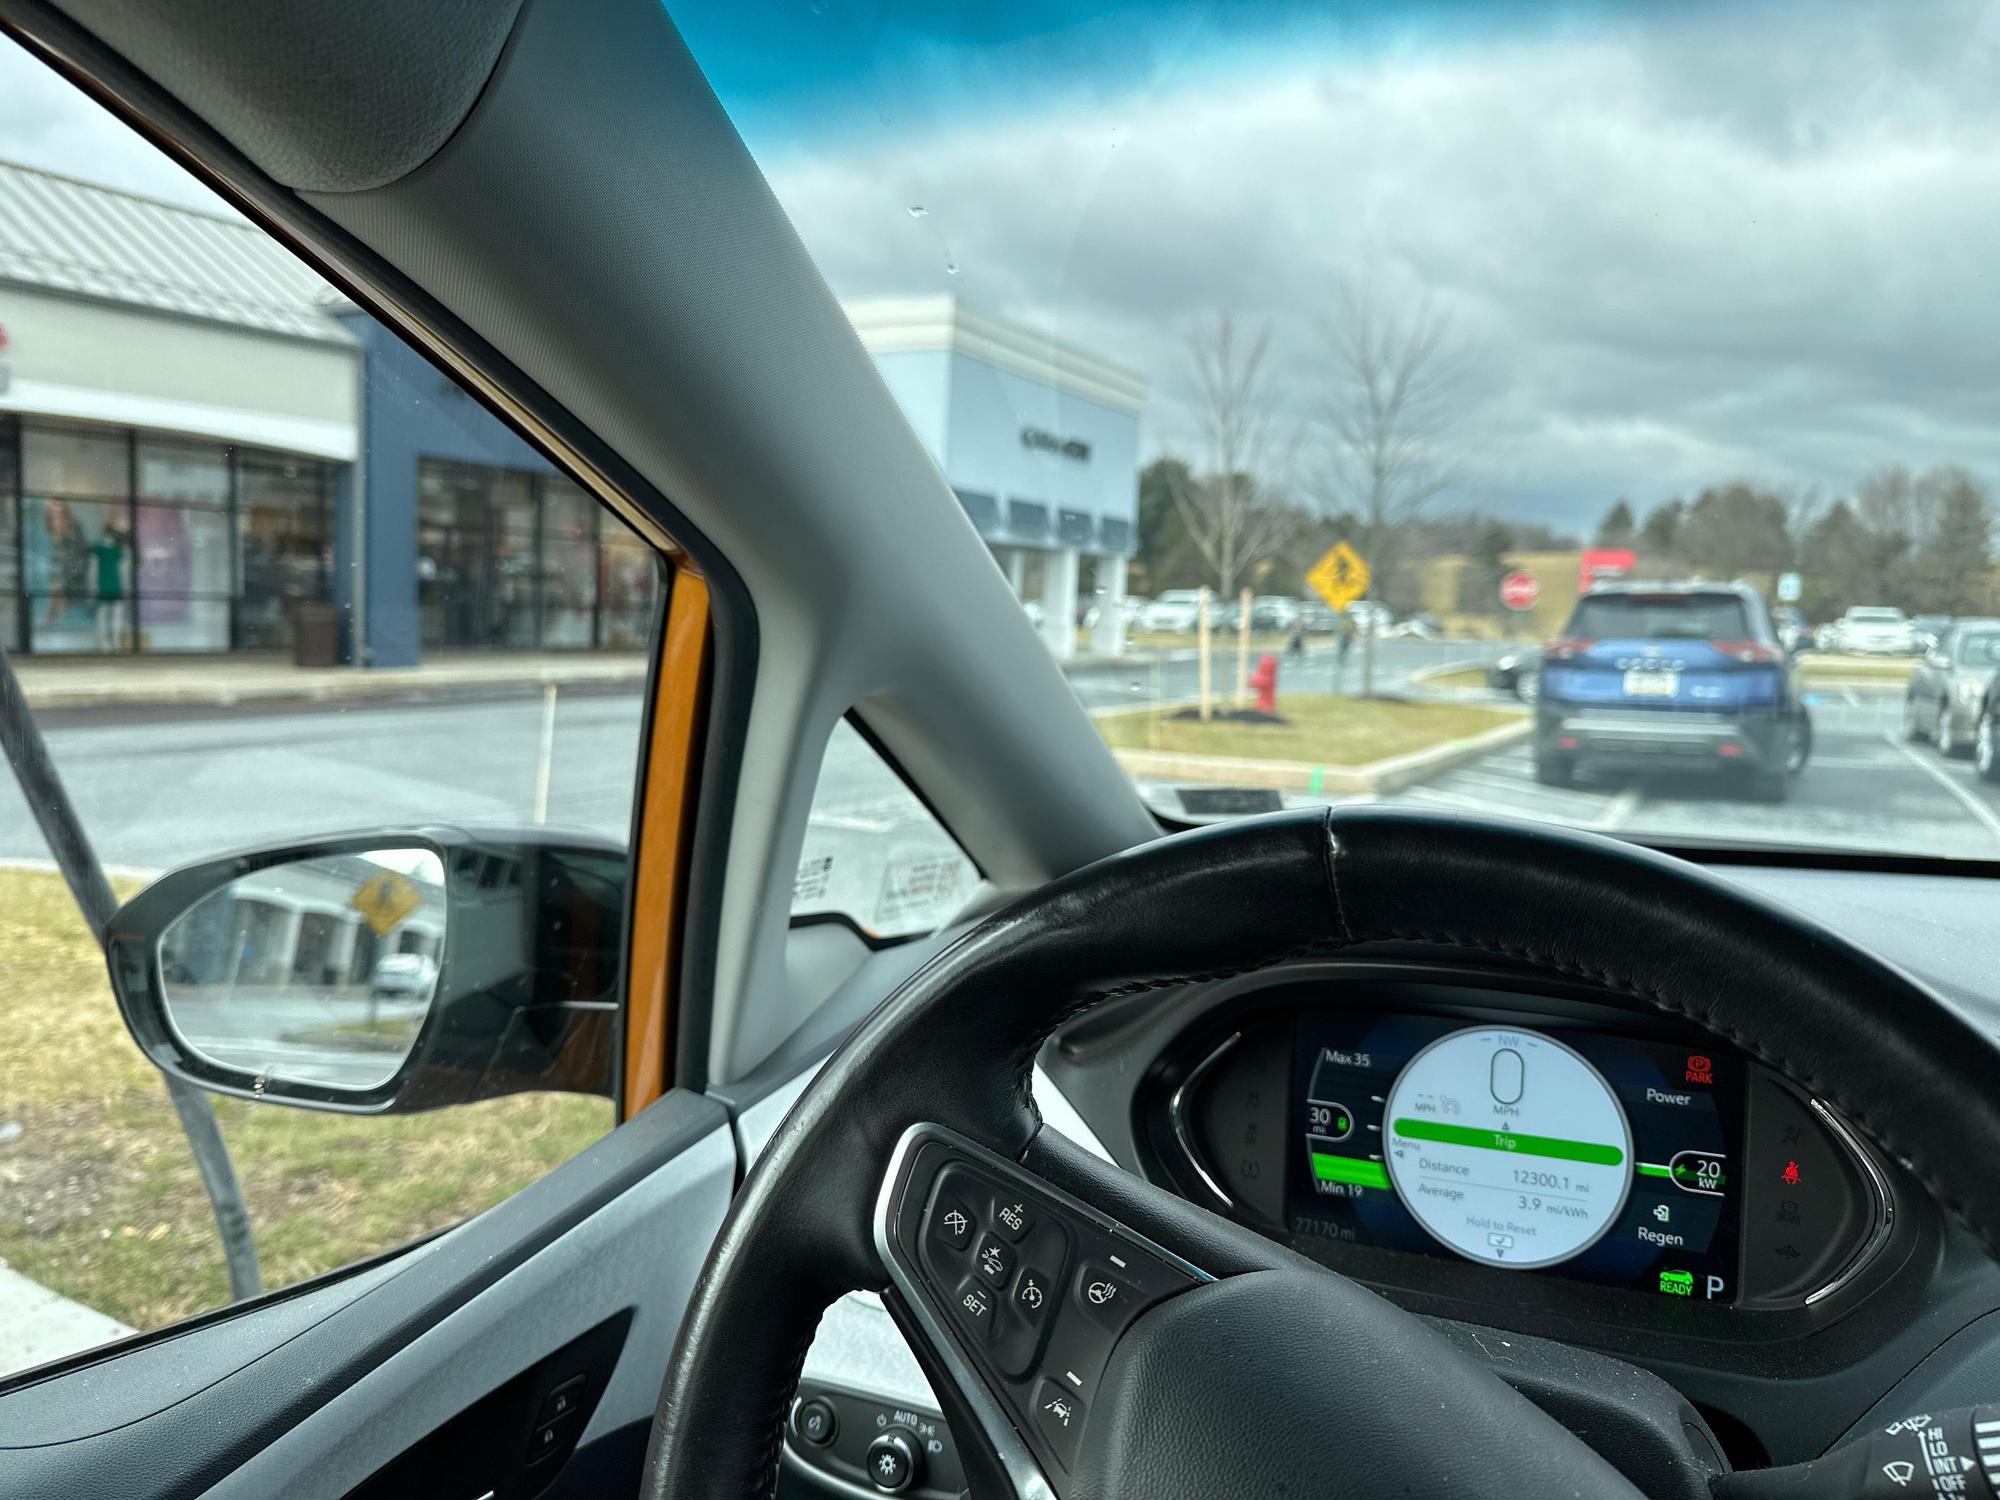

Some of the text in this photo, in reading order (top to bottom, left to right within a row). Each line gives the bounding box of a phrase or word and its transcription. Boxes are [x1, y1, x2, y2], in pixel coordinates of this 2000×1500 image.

[1498, 1035, 1520, 1046] NW
[1325, 1049, 1371, 1068] Max 35
[1490, 1048, 1524, 1104] 0
[1685, 1071, 1712, 1084] PARK
[1646, 1087, 1691, 1106] Power
[1310, 1107, 1331, 1126] 30
[1414, 1102, 1436, 1113] MPH
[1493, 1105, 1519, 1116] MPH
[1392, 1137, 1421, 1150] Menu
[1494, 1134, 1517, 1149] Trip
[1419, 1158, 1590, 1193] Distance 12300.1 mi
[1696, 1160, 1720, 1178] 20
[1321, 1180, 1364, 1197] Min 19
[1698, 1178, 1717, 1190] kW
[1418, 1184, 1589, 1219] Average 3.9 mi/kWh
[999, 1207, 1023, 1230] RES
[1466, 1216, 1537, 1236] Hold to Reset
[1296, 1216, 1355, 1240] 77170 mi
[1638, 1226, 1683, 1247] Regen
[1660, 1280, 1693, 1296] READY
[1706, 1275, 1724, 1300] P
[963, 1294, 987, 1316] SET
[894, 1410, 918, 1426] AUTO
[1928, 1427, 1943, 1441] HI
[1929, 1441, 1948, 1457] LO
[1933, 1456, 1957, 1474] INT
[1939, 1474, 1966, 1492] OFF
